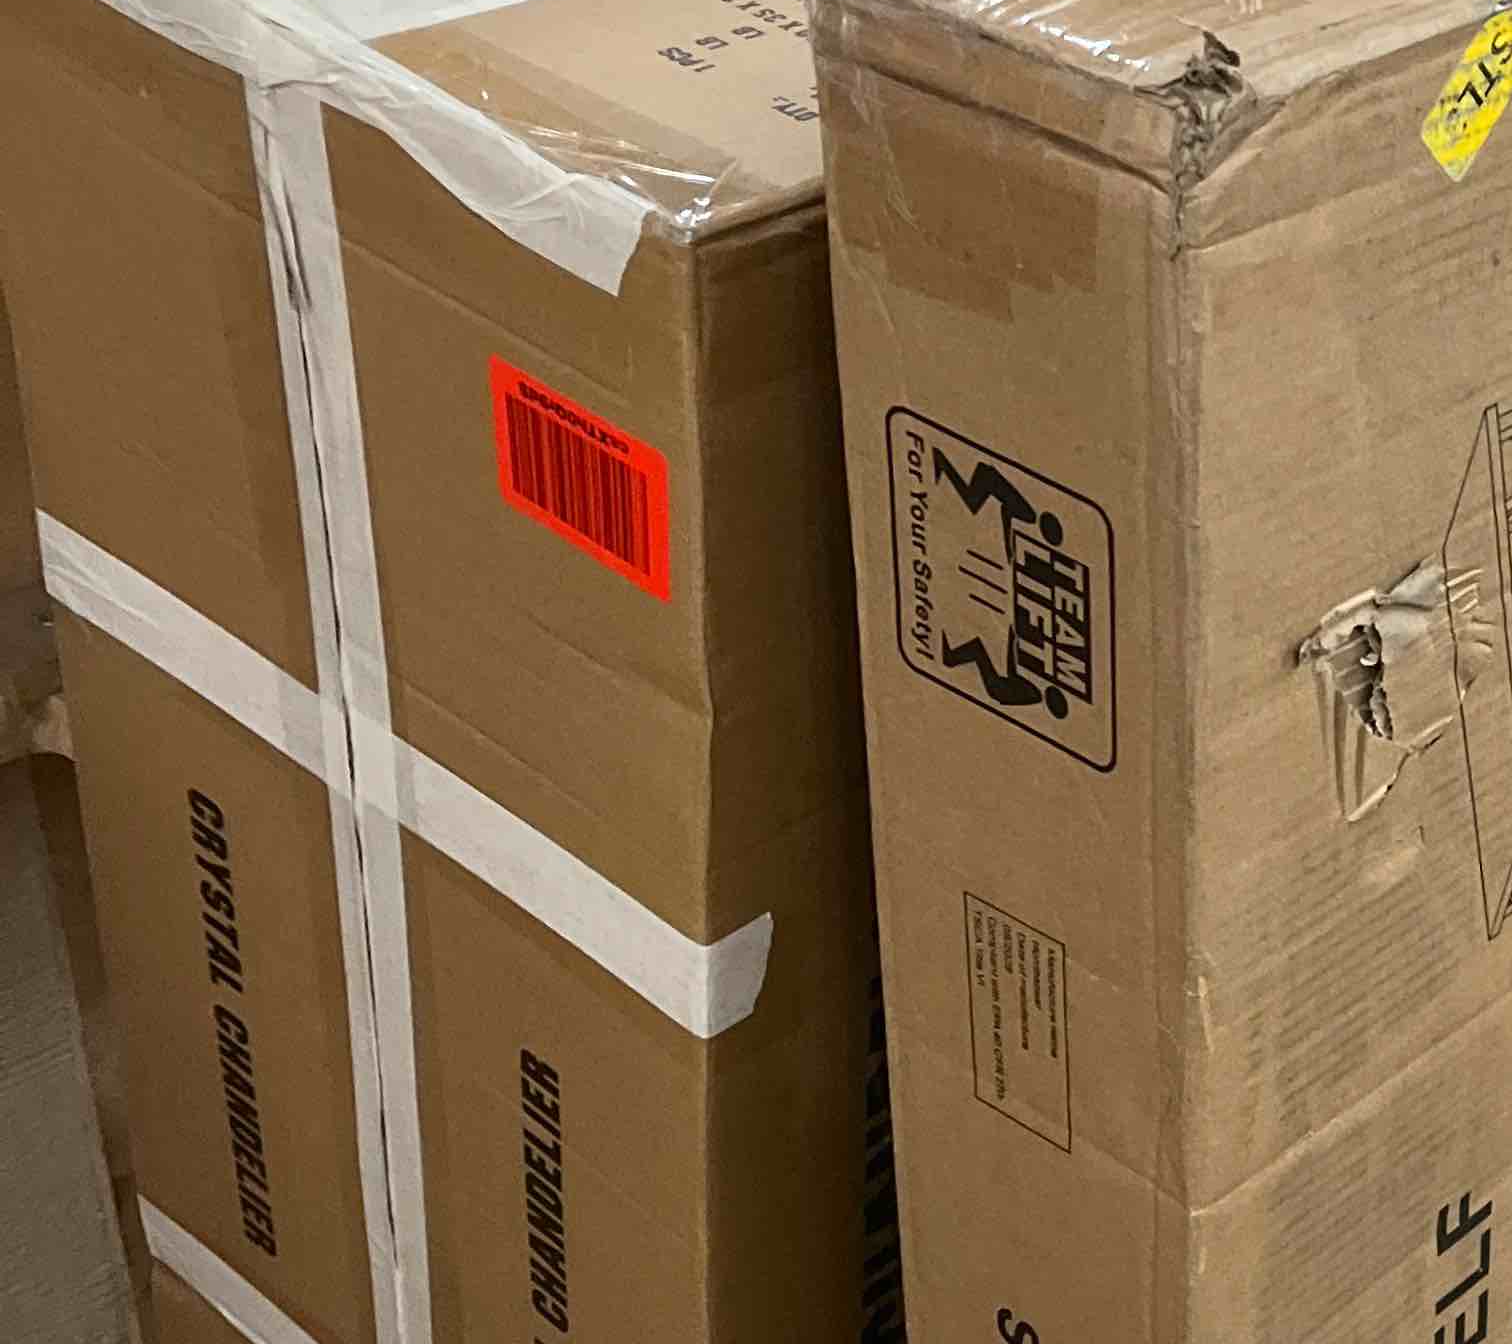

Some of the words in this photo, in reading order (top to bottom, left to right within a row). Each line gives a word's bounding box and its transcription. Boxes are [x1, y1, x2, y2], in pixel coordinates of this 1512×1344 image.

[906, 431, 924, 483] For
[910, 491, 928, 555] Your
[912, 560, 934, 660] Safety!
[1012, 523, 1056, 688] LIFT
[1052, 547, 1088, 704] TEAM
[188, 787, 244, 995] CRYSTAL
[214, 1004, 277, 1258] CHANDELIER
[520, 1049, 568, 1335] CHANDELIER
